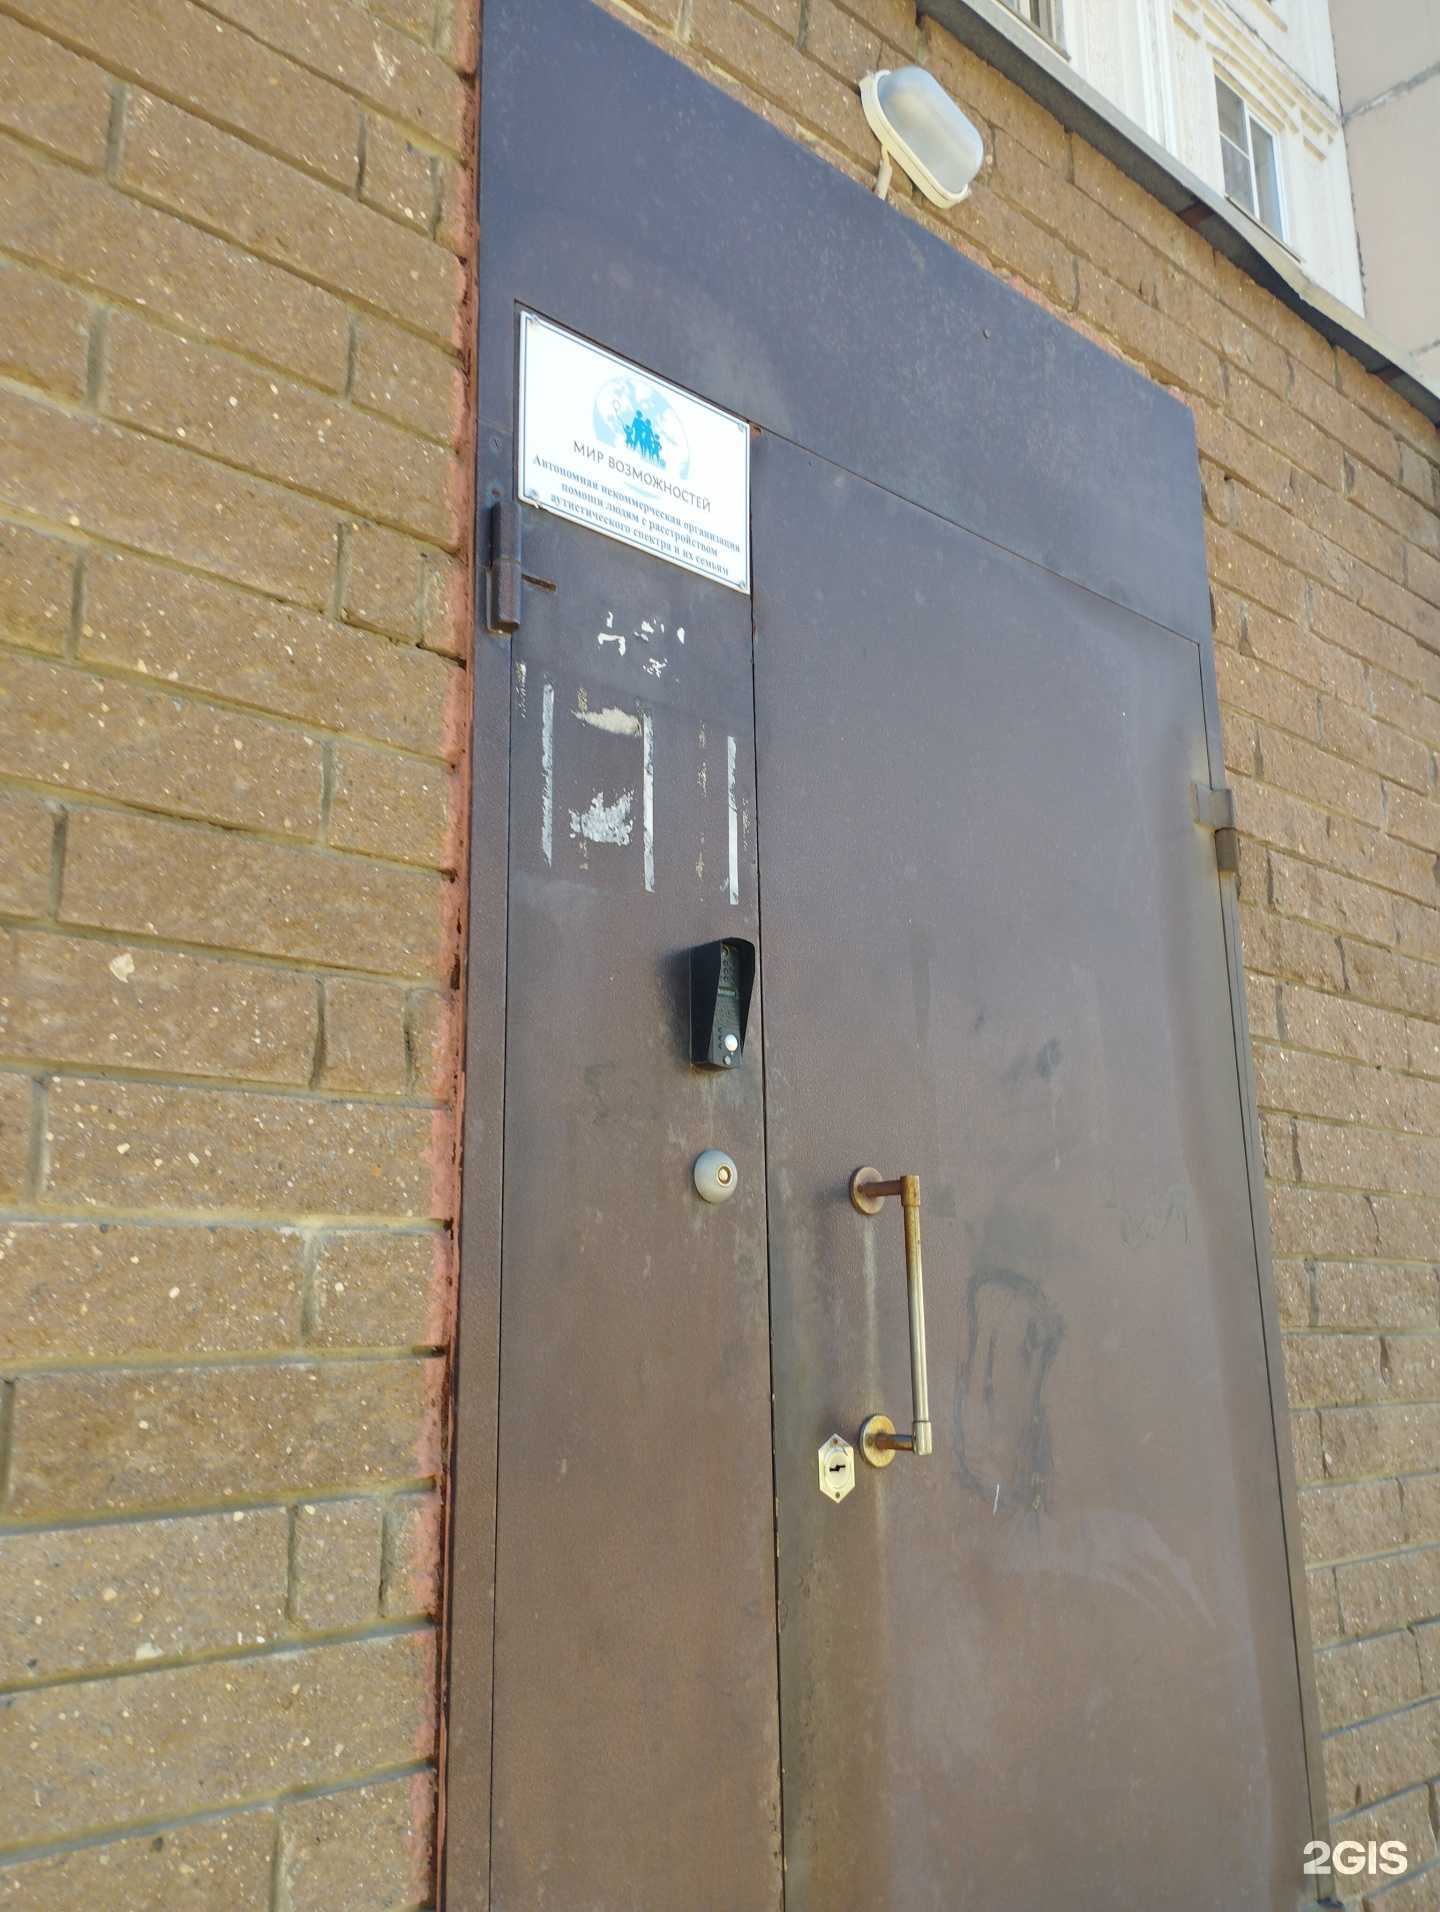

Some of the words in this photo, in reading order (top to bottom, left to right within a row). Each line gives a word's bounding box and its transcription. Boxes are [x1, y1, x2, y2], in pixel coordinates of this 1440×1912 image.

[533, 453, 599, 490] Автономная
[600, 485, 682, 528] некоммерческая
[572, 440, 604, 463] МИР
[608, 455, 711, 512] ВОЗМОЖНОСТЕЙ
[551, 494, 631, 533] аутистического
[633, 528, 672, 552] спектра
[682, 549, 694, 561] их
[561, 483, 603, 507] помощи
[605, 501, 640, 523] людям
[648, 519, 718, 558] расстройством
